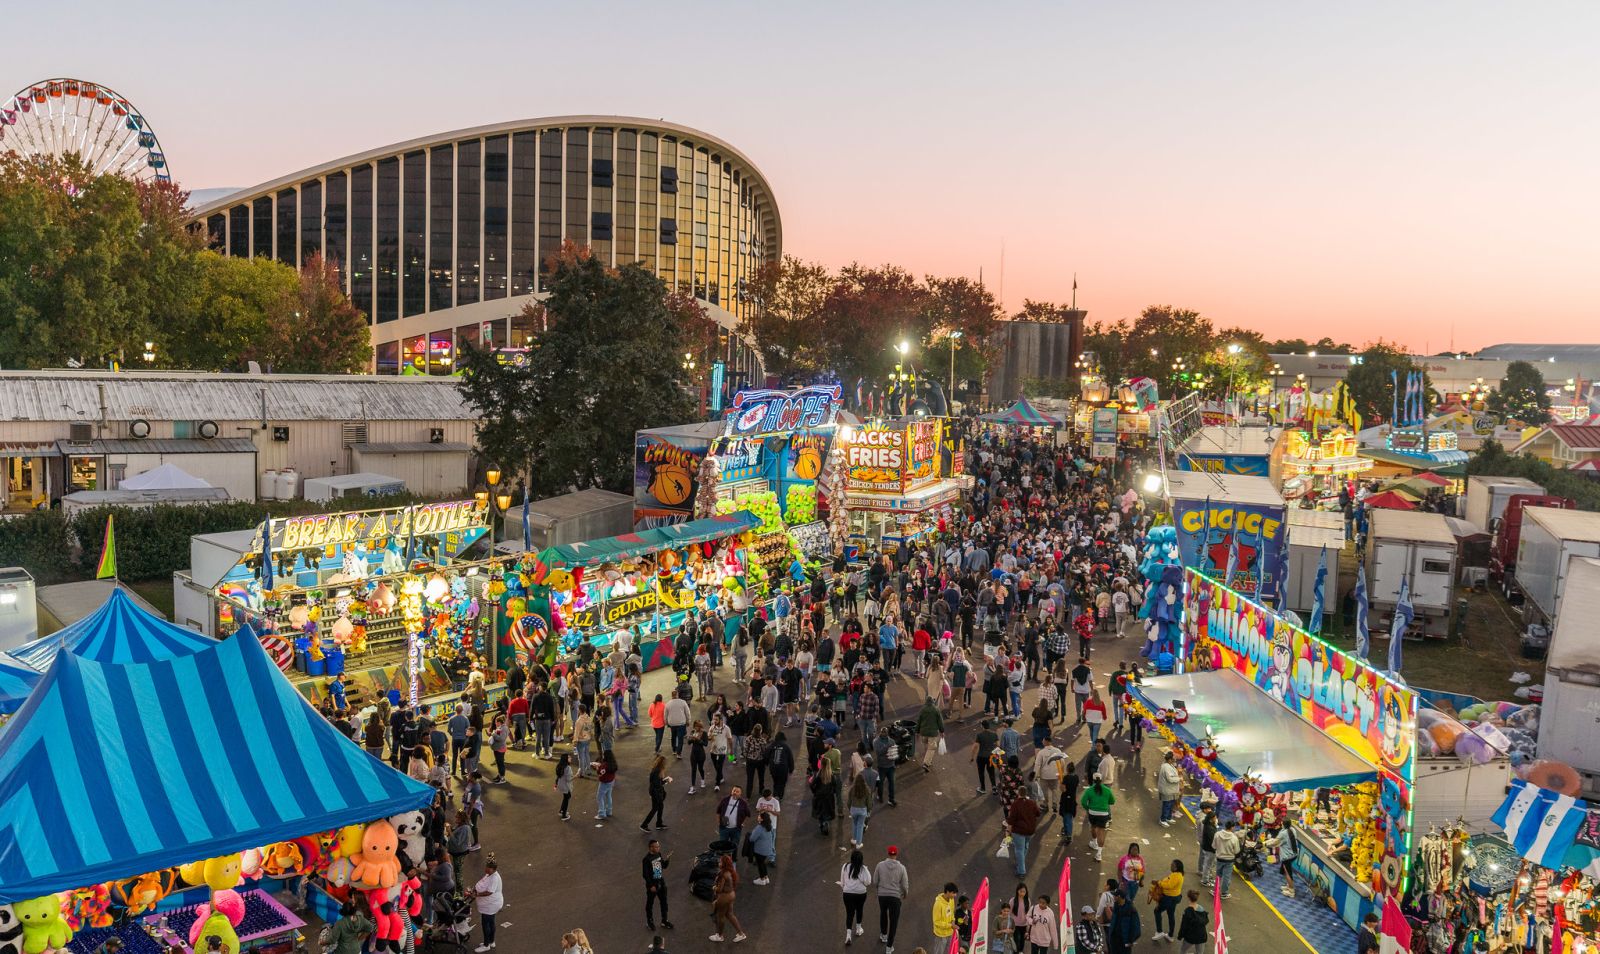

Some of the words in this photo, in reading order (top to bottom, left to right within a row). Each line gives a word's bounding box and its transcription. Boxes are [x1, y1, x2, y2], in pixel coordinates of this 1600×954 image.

[762, 396, 829, 432] HOOPS
[849, 430, 903, 446] JACK'S
[849, 446, 903, 468] FRIES
[1188, 458, 1226, 475] WIN
[849, 480, 874, 489] CHICKEN
[875, 482, 901, 490] TENDERS
[872, 500, 891, 508] FRIES
[283, 515, 359, 548] BREAK
[368, 510, 389, 538] A
[401, 501, 473, 537] BOTTLE
[1181, 508, 1281, 539] CHOICE
[1207, 606, 1271, 674] BALLOON
[1295, 656, 1376, 736] BLAST
